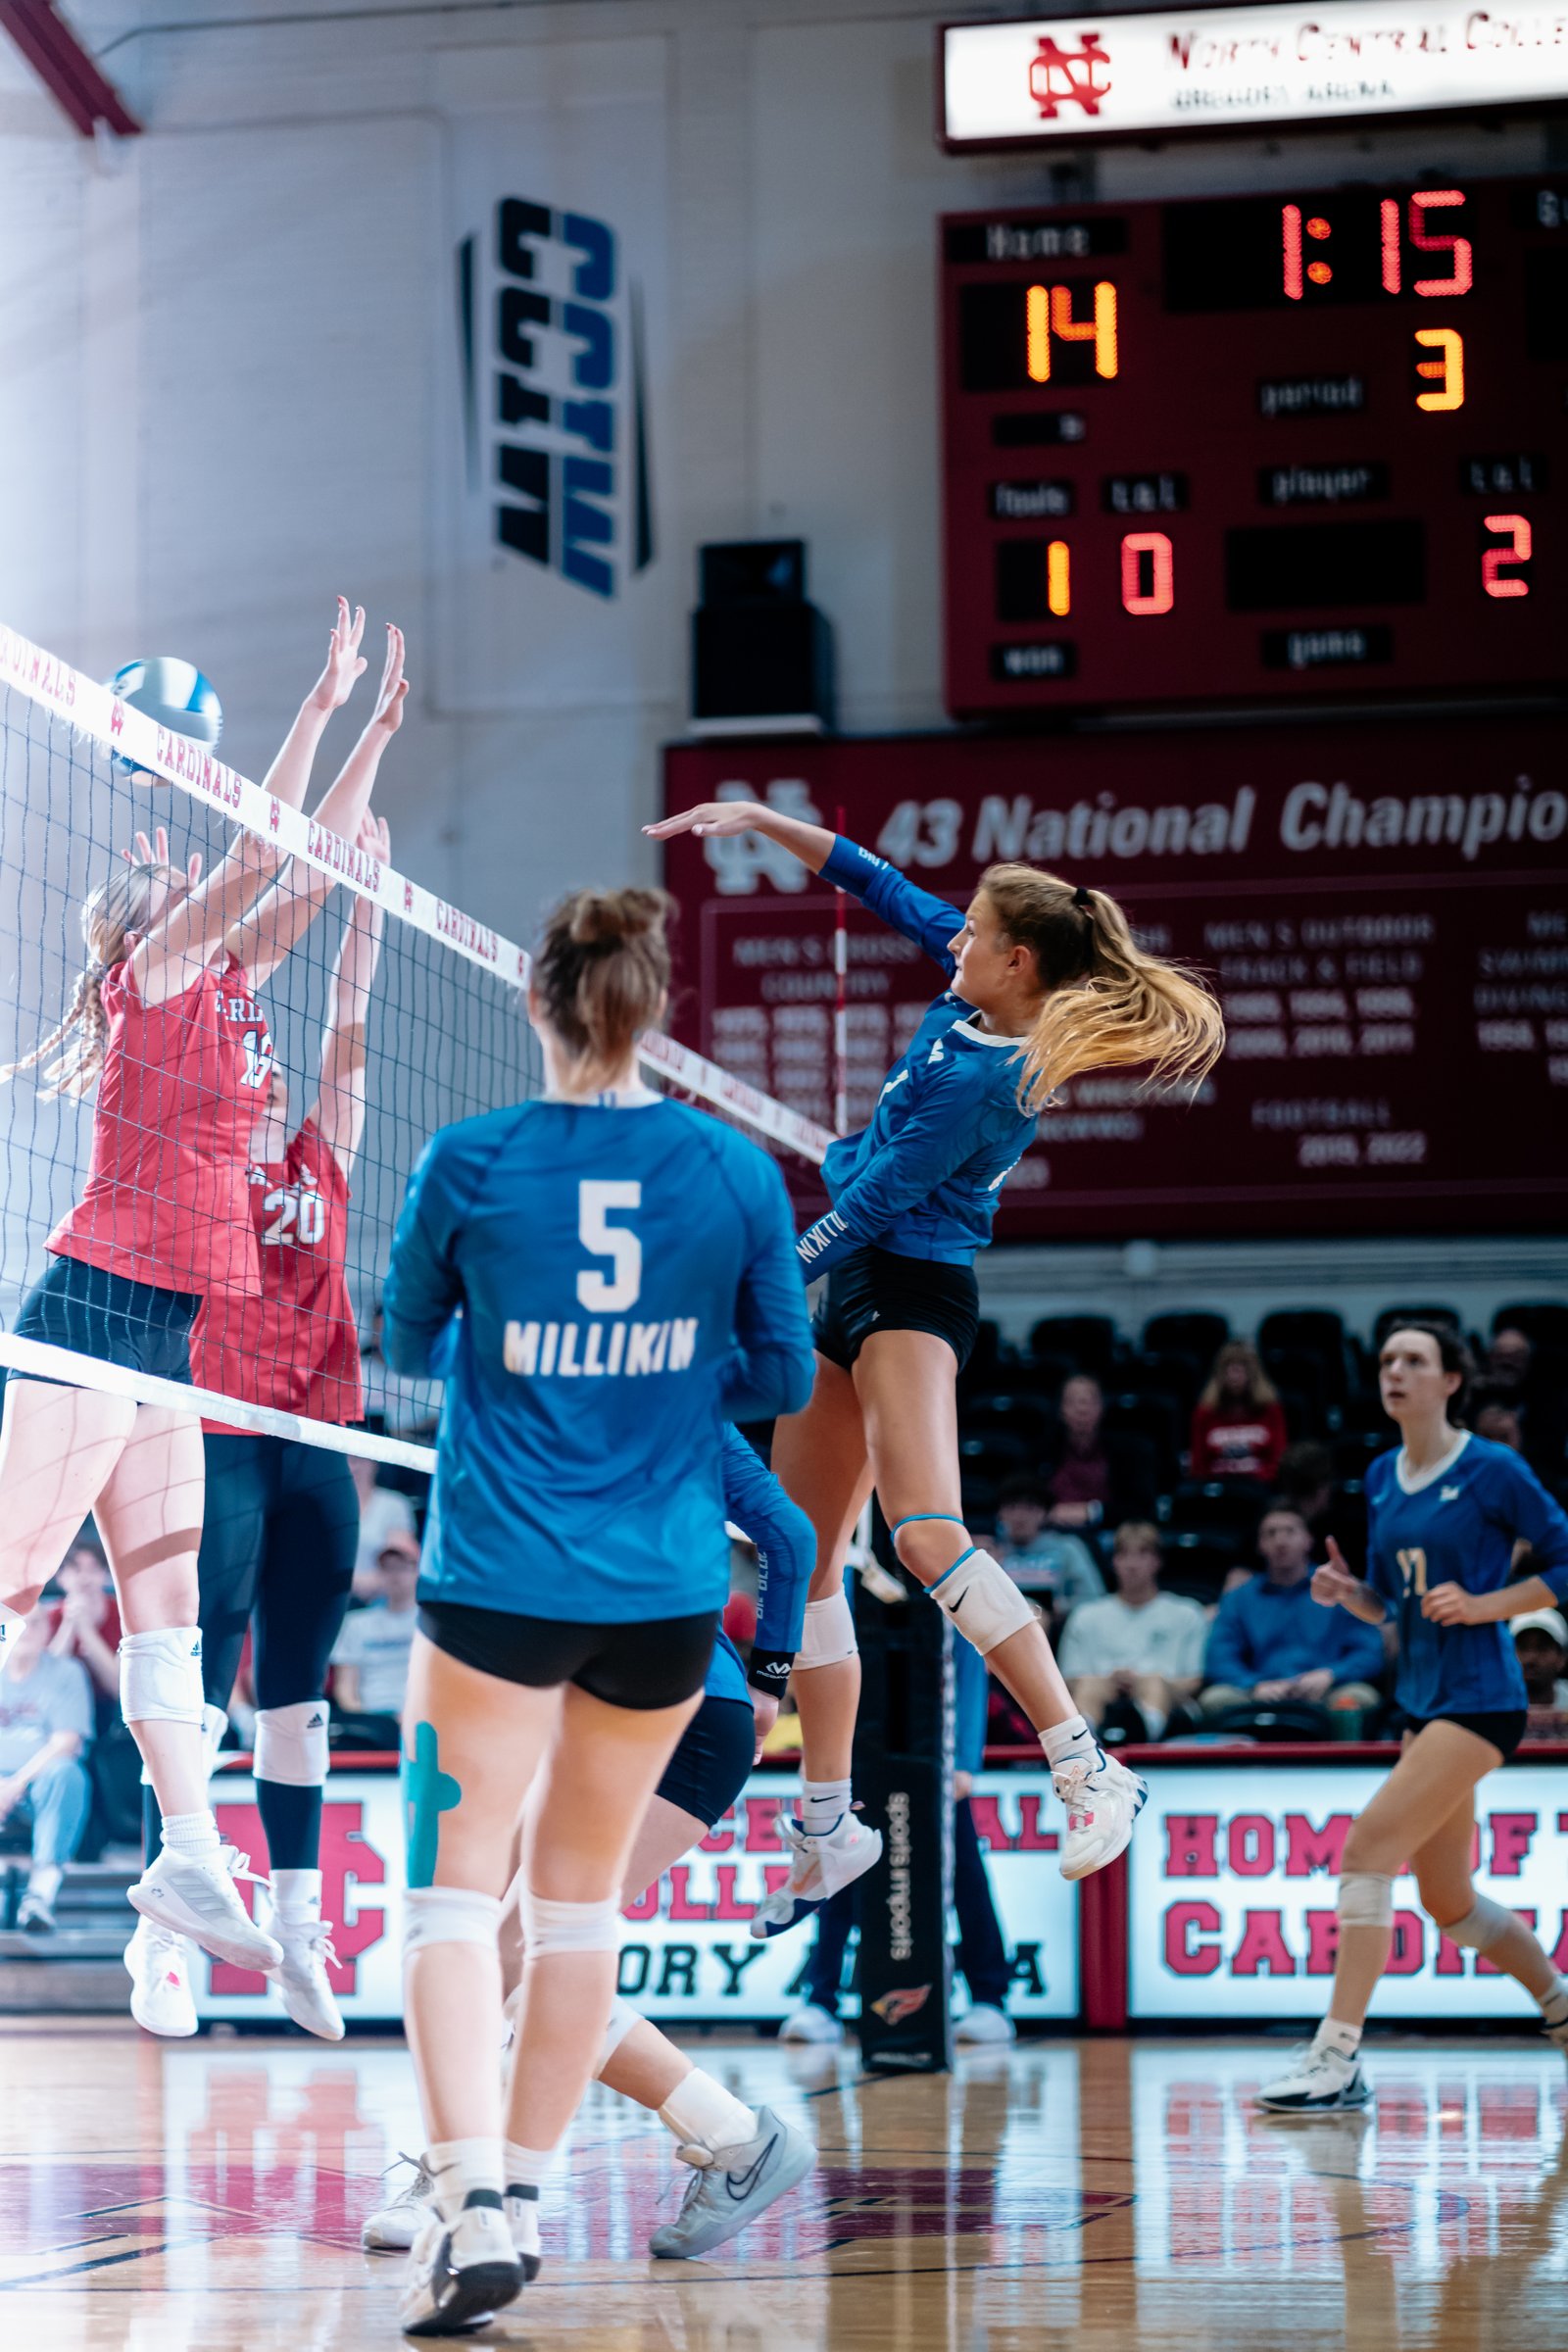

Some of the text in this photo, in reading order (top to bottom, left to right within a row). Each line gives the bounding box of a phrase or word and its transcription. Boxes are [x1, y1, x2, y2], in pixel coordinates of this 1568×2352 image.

[1282, 189, 1473, 300] 1:15
[1025, 281, 1118, 382] 14
[1413, 328, 1466, 412] 3
[1048, 540, 1070, 616] 1
[1121, 532, 1174, 615] 0
[1482, 514, 1532, 598] 2
[157, 724, 243, 808] CARDINALS
[308, 818, 381, 893] CARDINALS
[876, 773, 1568, 868] 43 National Champio
[261, 1188, 326, 1246] 20
[576, 1179, 642, 1313] 5
[795, 1210, 849, 1264] ILLIKIN
[503, 1317, 699, 1377] MILLIKIN
